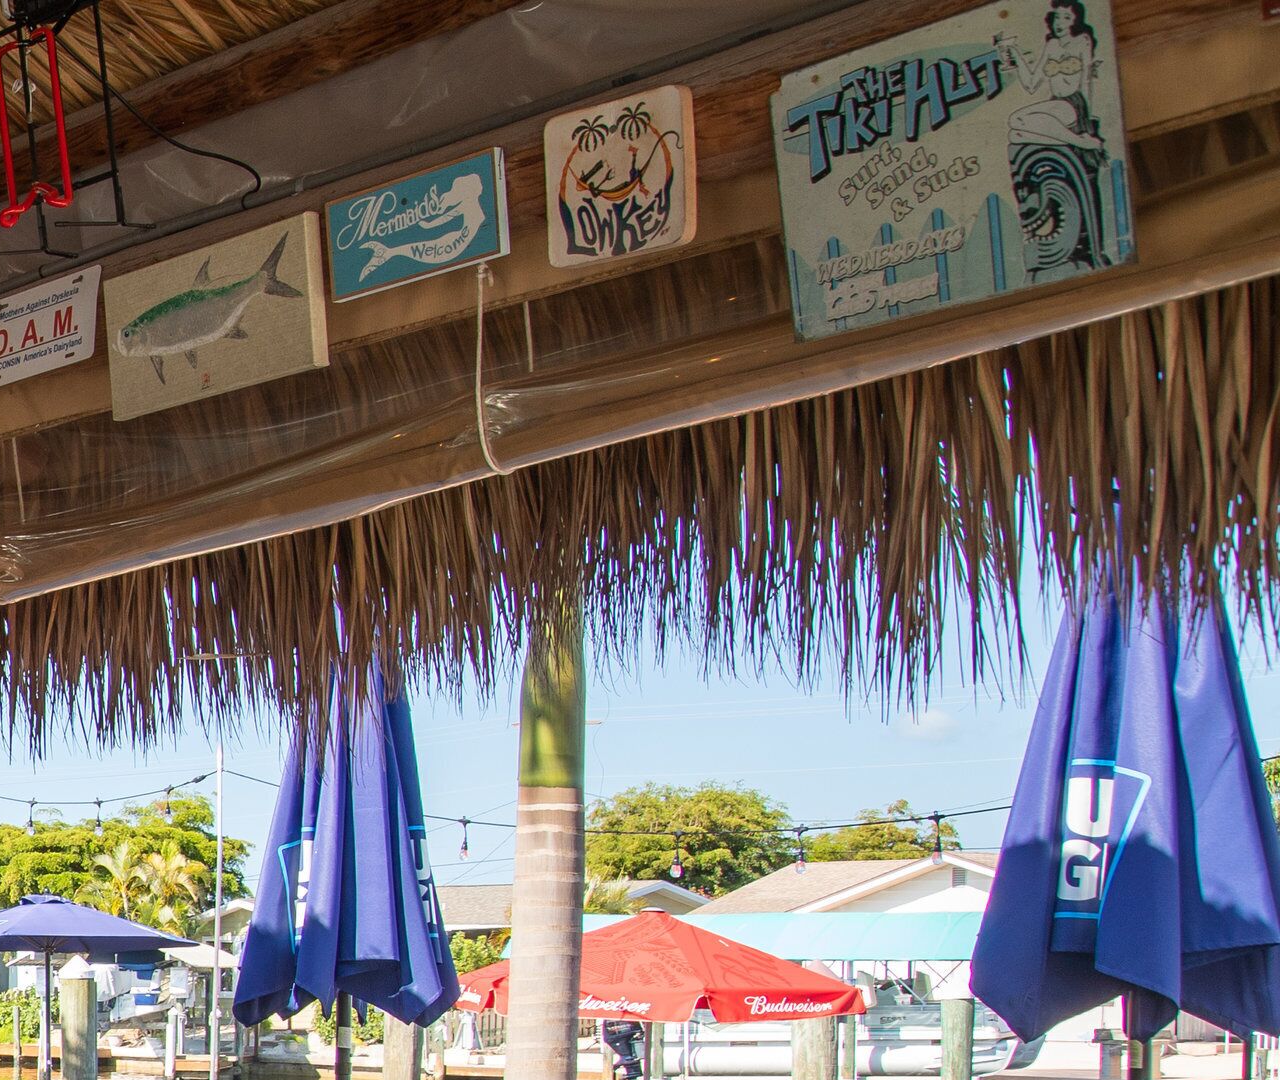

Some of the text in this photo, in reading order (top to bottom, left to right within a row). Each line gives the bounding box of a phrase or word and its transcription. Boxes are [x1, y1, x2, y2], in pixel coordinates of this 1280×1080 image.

[840, 60, 907, 101] THE
[787, 50, 1004, 184] TIKI HUT
[865, 146, 937, 209] Sand,
[890, 156, 980, 222] & Suds
[410, 225, 470, 259] Welcome
[0, 287, 79, 320] Mothers Against Dyslexia
[23, 346, 52, 362] America's
[53, 337, 83, 353] Dairyland
[744, 996, 833, 1015] Budweiser
